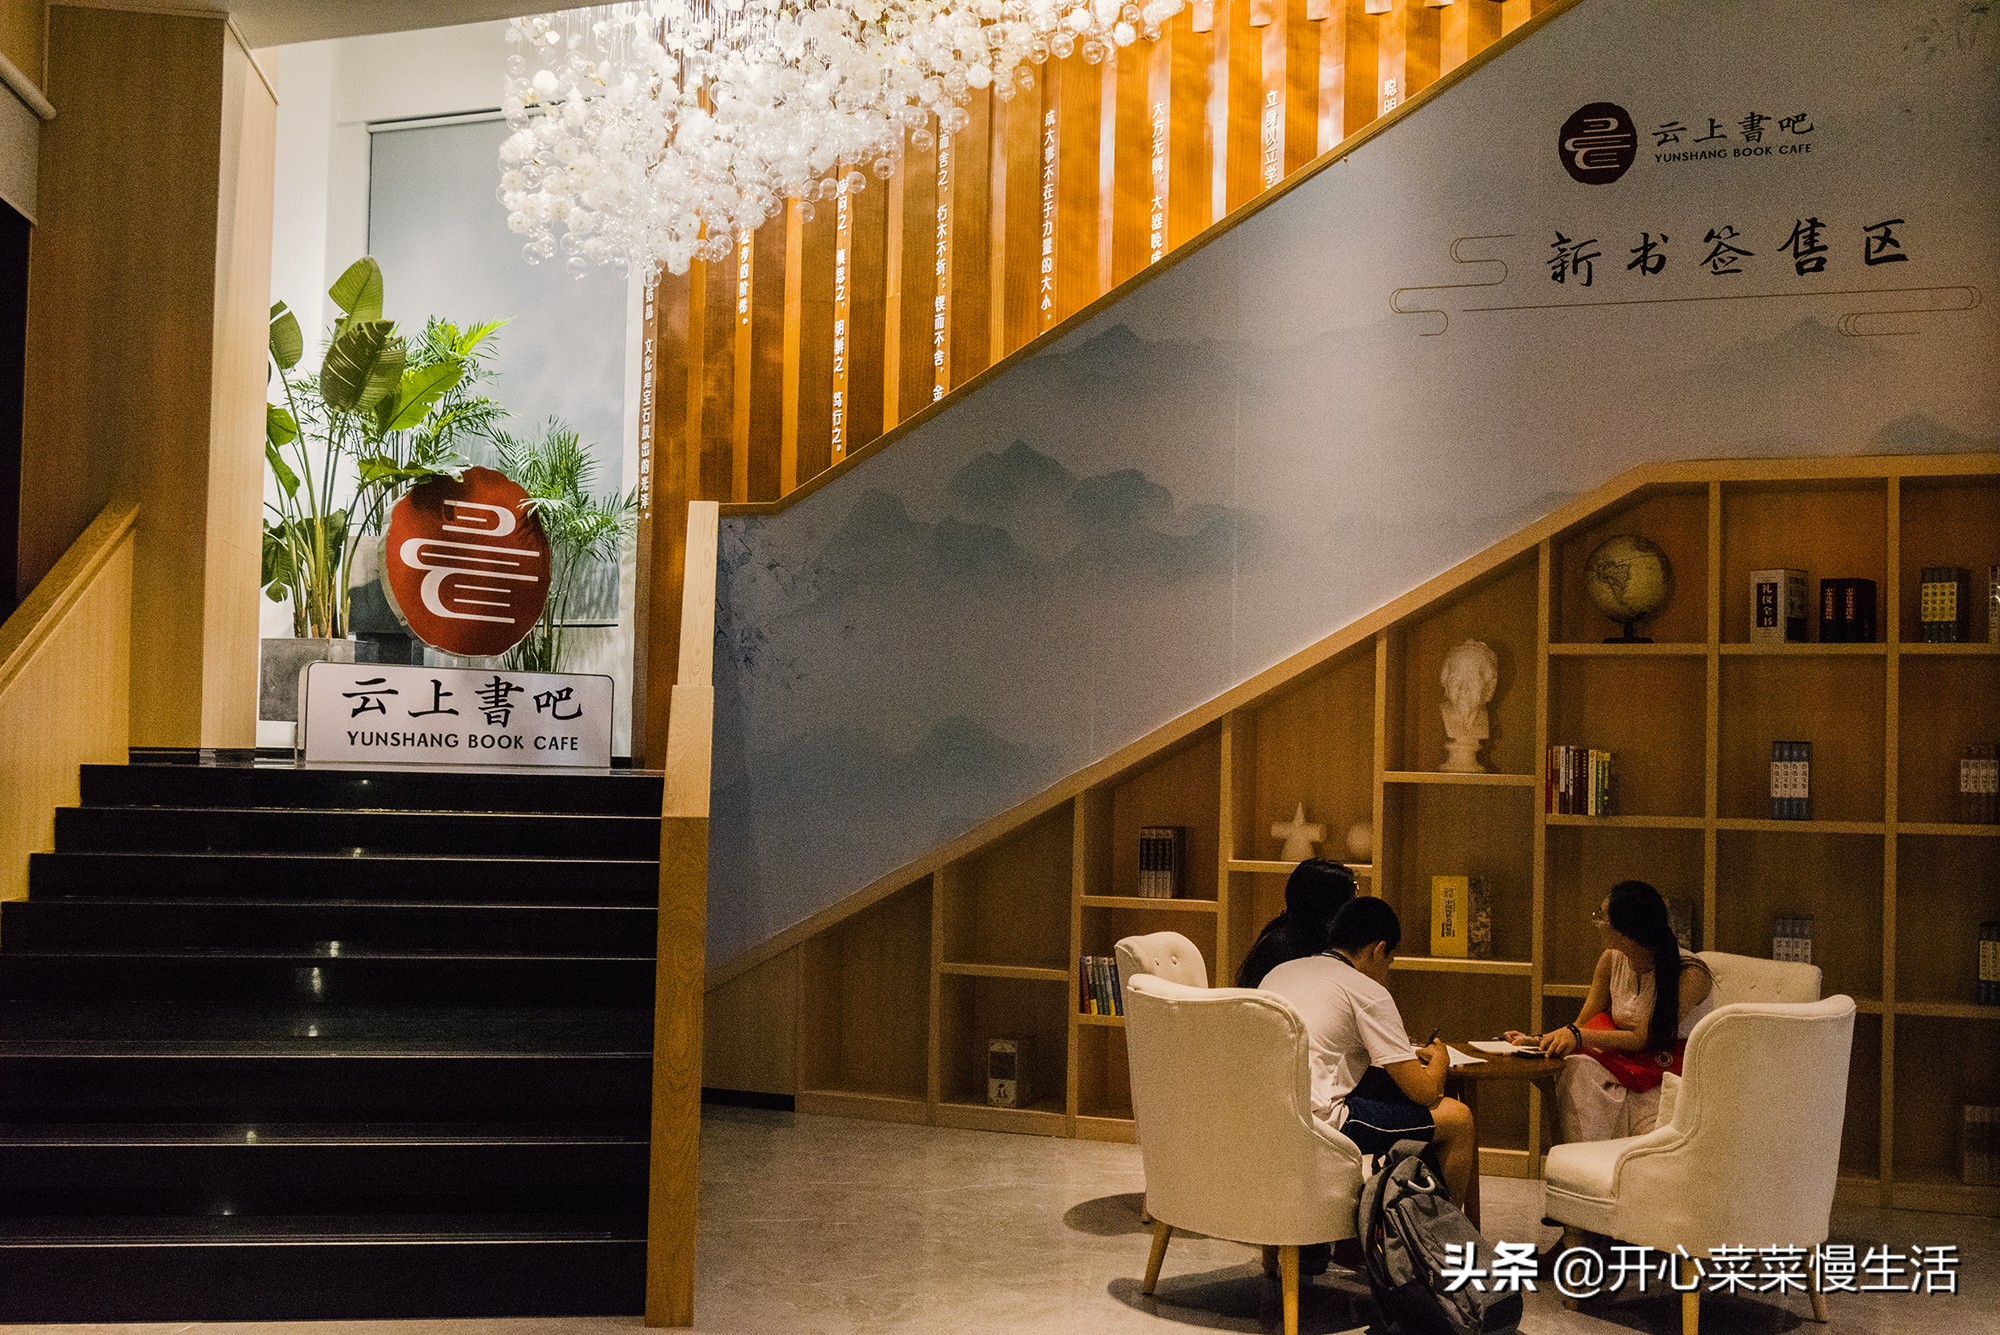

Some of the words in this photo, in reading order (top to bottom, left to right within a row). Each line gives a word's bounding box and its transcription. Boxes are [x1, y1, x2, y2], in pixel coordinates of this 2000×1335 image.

[1383, 76, 1398, 114] 聪明
[1264, 89, 1279, 190] 立身以立学
[1652, 111, 1815, 146] 云上書吧
[1654, 148, 1728, 164] YUNSHANG
[1733, 145, 1773, 159] BOOK
[1778, 143, 1812, 156] CAFE
[1040, 108, 1056, 336] 成大事不在于力量的大小，
[1546, 216, 1909, 288] 新书签售区
[341, 675, 583, 729] 云上書吧
[346, 730, 460, 749] YUNSHANG
[468, 734, 525, 750] BOOK
[533, 735, 579, 751] CAFE
